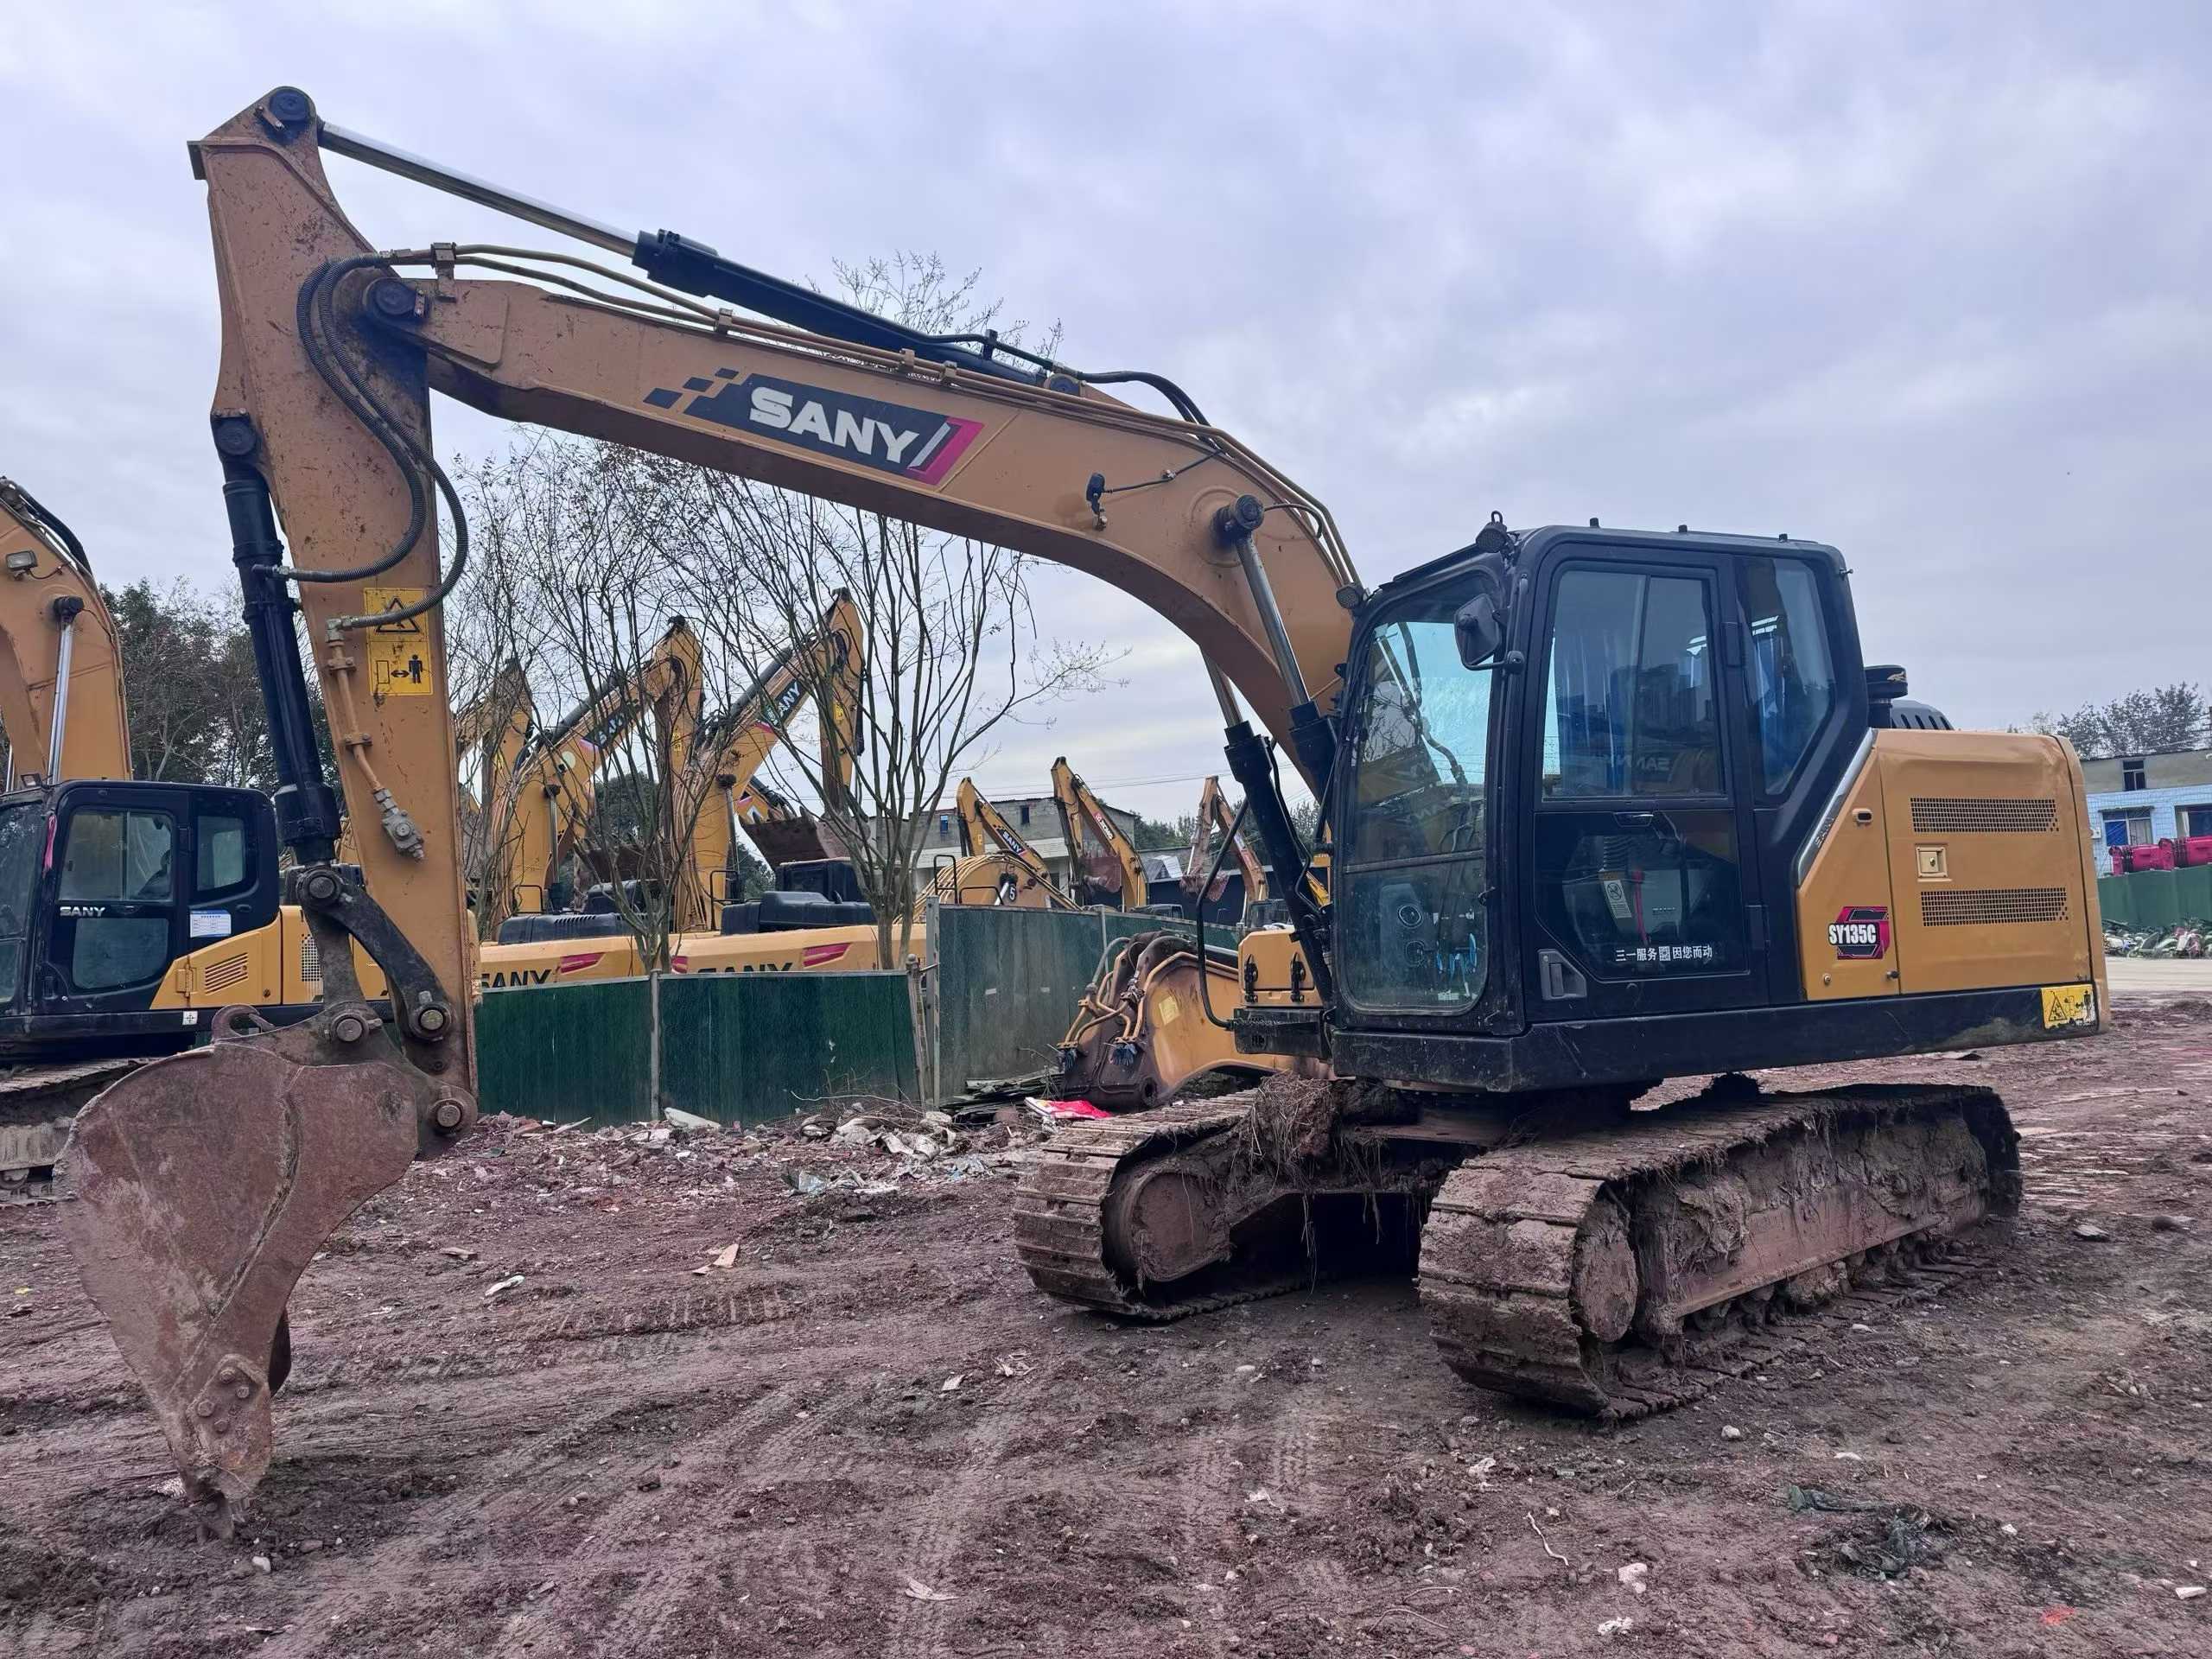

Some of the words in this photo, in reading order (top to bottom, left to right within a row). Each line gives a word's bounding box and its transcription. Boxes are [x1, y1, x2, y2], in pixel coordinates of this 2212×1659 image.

[749, 386, 920, 464] SANY
[1002, 830, 1022, 853] SANY
[60, 906, 105, 917] SANY
[1828, 924, 1877, 944] SY135C
[1616, 947, 1657, 962] 三一服务
[1672, 945, 1713, 959] 因您而动
